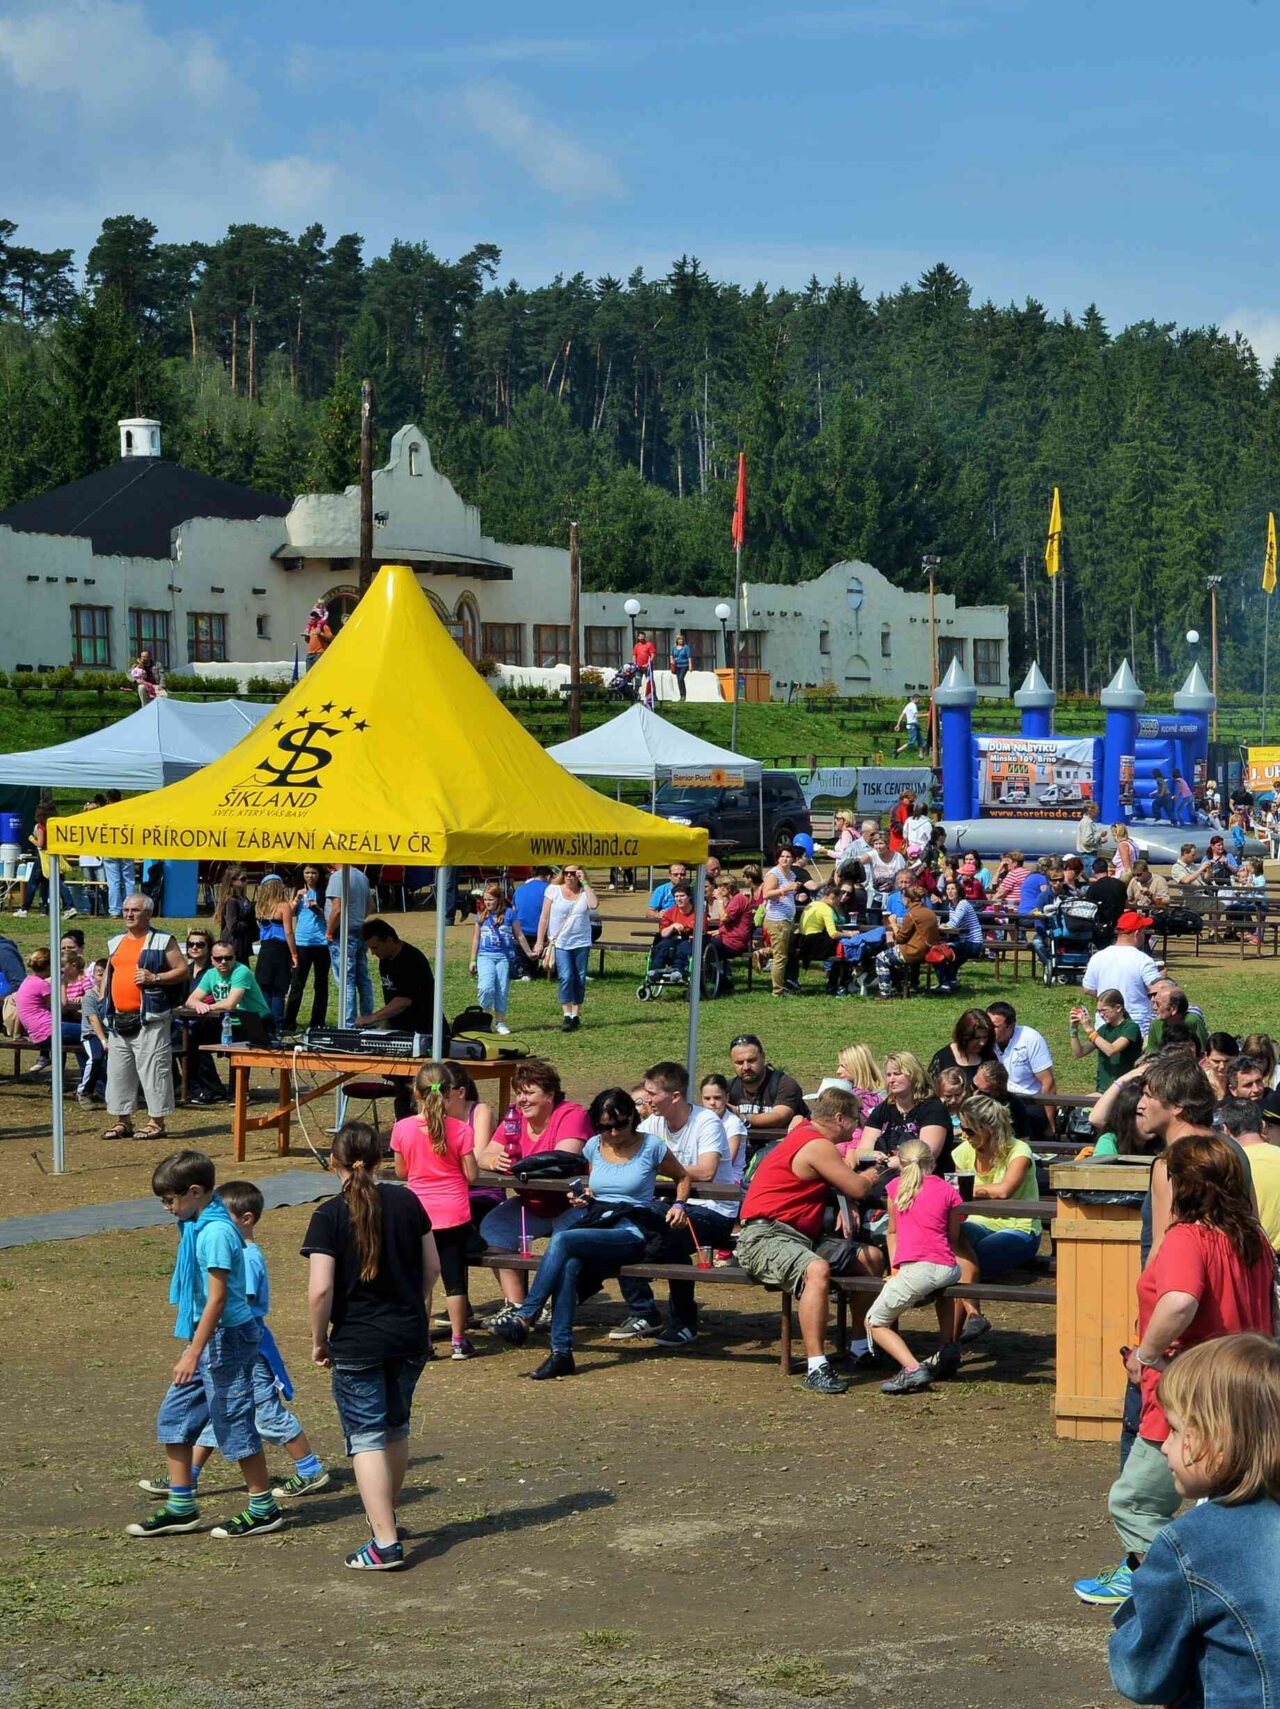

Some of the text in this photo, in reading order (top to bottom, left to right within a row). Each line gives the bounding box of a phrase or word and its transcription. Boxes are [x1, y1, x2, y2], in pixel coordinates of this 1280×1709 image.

[1038, 755, 1057, 764] Brno
[862, 782, 882, 796] TISK
[218, 788, 318, 808] ŠIKLAND
[989, 809, 1084, 818] www.noretrade.cz
[55, 824, 432, 853] NEJVĚTŠÍ PŘÍRODNÍ ZÁBAVNÍ AREÁL V ČR
[530, 834, 639, 856] www.sikland.cz
